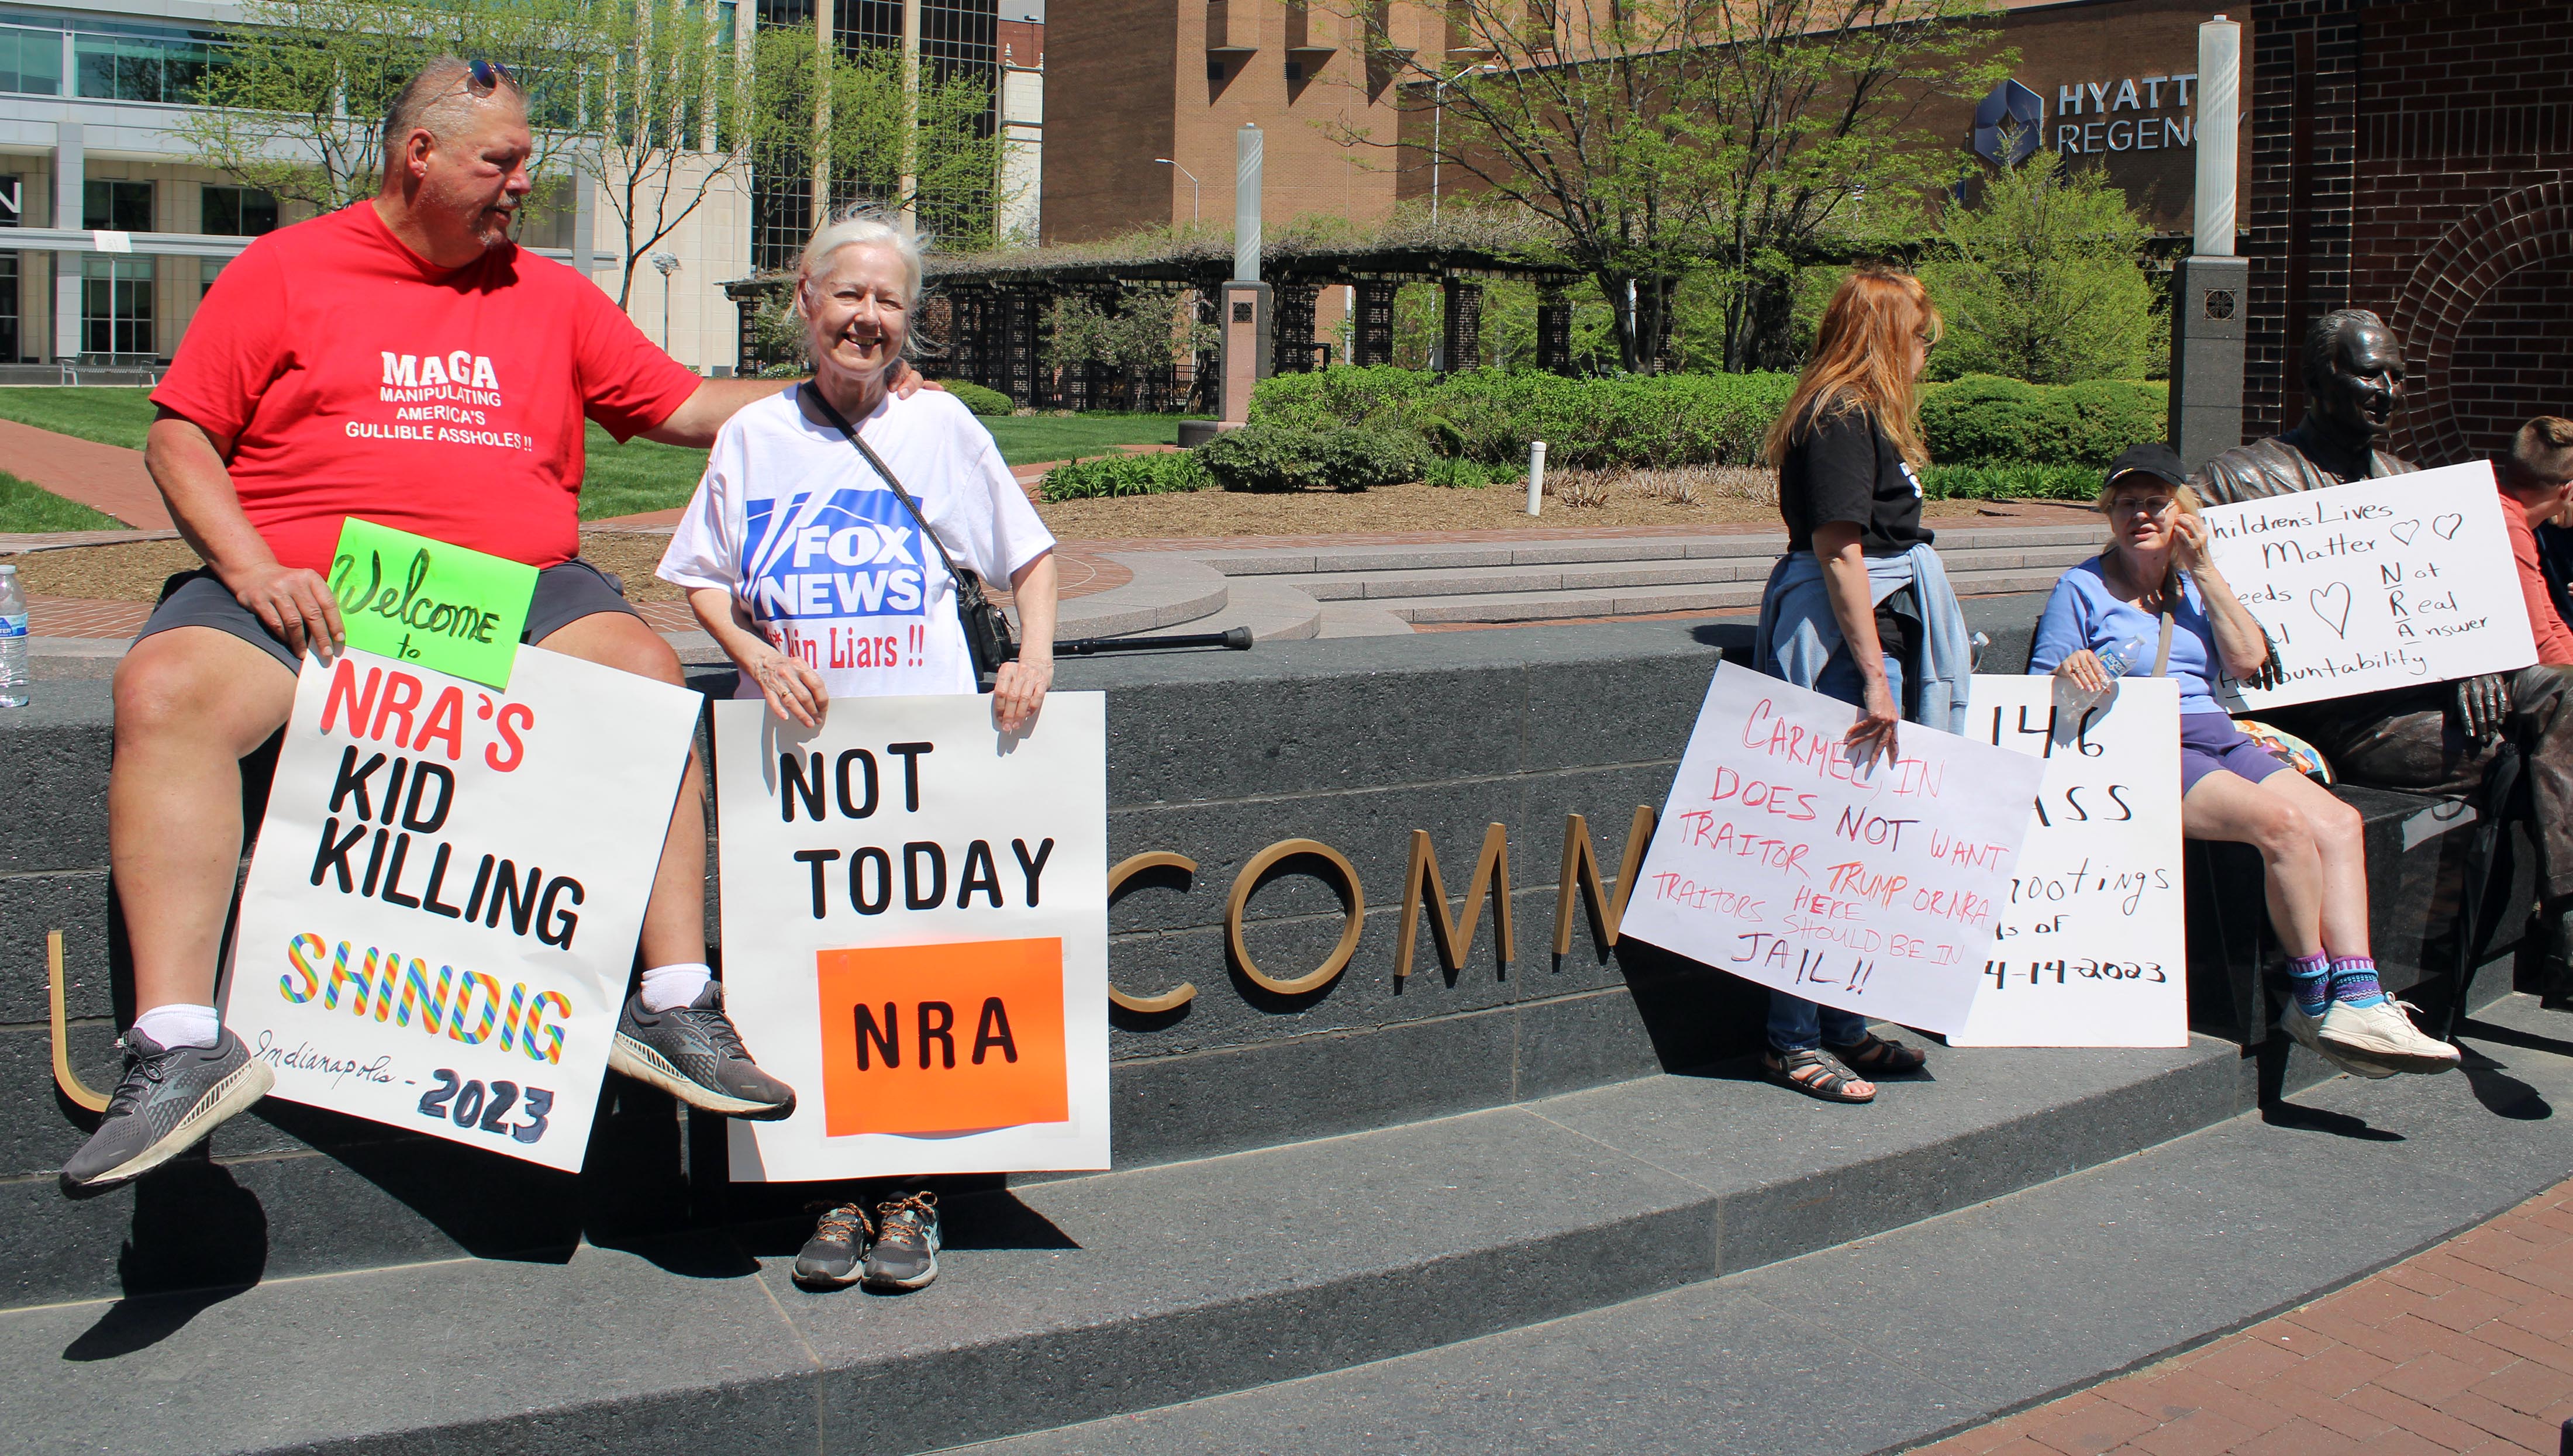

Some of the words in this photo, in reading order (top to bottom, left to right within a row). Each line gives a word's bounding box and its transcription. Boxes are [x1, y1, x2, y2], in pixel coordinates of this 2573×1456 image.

[2058, 74, 2198, 116] HYATT
[2058, 112, 2246, 154] REGEN
[381, 350, 499, 390] MAGA
[380, 385, 502, 408] MANIPULATING
[396, 405, 486, 426] AMERICA'S
[346, 421, 434, 440] GULLIBLE
[438, 427, 521, 449] ASSHOLES
[2202, 511, 2312, 539] hildren's
[2316, 501, 2394, 524] Lives
[792, 524, 920, 568] FOX
[2262, 533, 2376, 569] Matter
[760, 569, 922, 618] NEWS
[2230, 583, 2292, 606] eeds
[397, 633, 421, 659] to
[829, 626, 898, 669] Liars
[320, 658, 534, 773] NRA'S
[1992, 705, 2105, 759] 146
[329, 744, 456, 834] KID
[780, 741, 934, 823] NOT
[1892, 755, 1946, 798] IN
[1708, 767, 1818, 821] DOES
[1836, 805, 1922, 853] NOT
[1930, 828, 2012, 872] WANT
[2032, 785, 2131, 827] SS
[310, 816, 585, 951] KILLING
[793, 837, 1055, 920] TODAY
[1679, 809, 1811, 880] TRAITOR
[1827, 861, 1908, 911] TRUMP
[1913, 887, 1948, 915] OR
[1946, 889, 1991, 930] NRA
[1652, 870, 1766, 922] TRAITORS
[1793, 885, 1866, 922] HERE
[1782, 914, 1882, 953] SHOULD
[1889, 934, 1926, 959] BE
[1930, 944, 1965, 966] IN
[279, 932, 572, 1065] SHINDIG
[853, 996, 1019, 1072] NRA
[253, 1029, 397, 1090] Indianapolis
[417, 1068, 555, 1144] 2023
